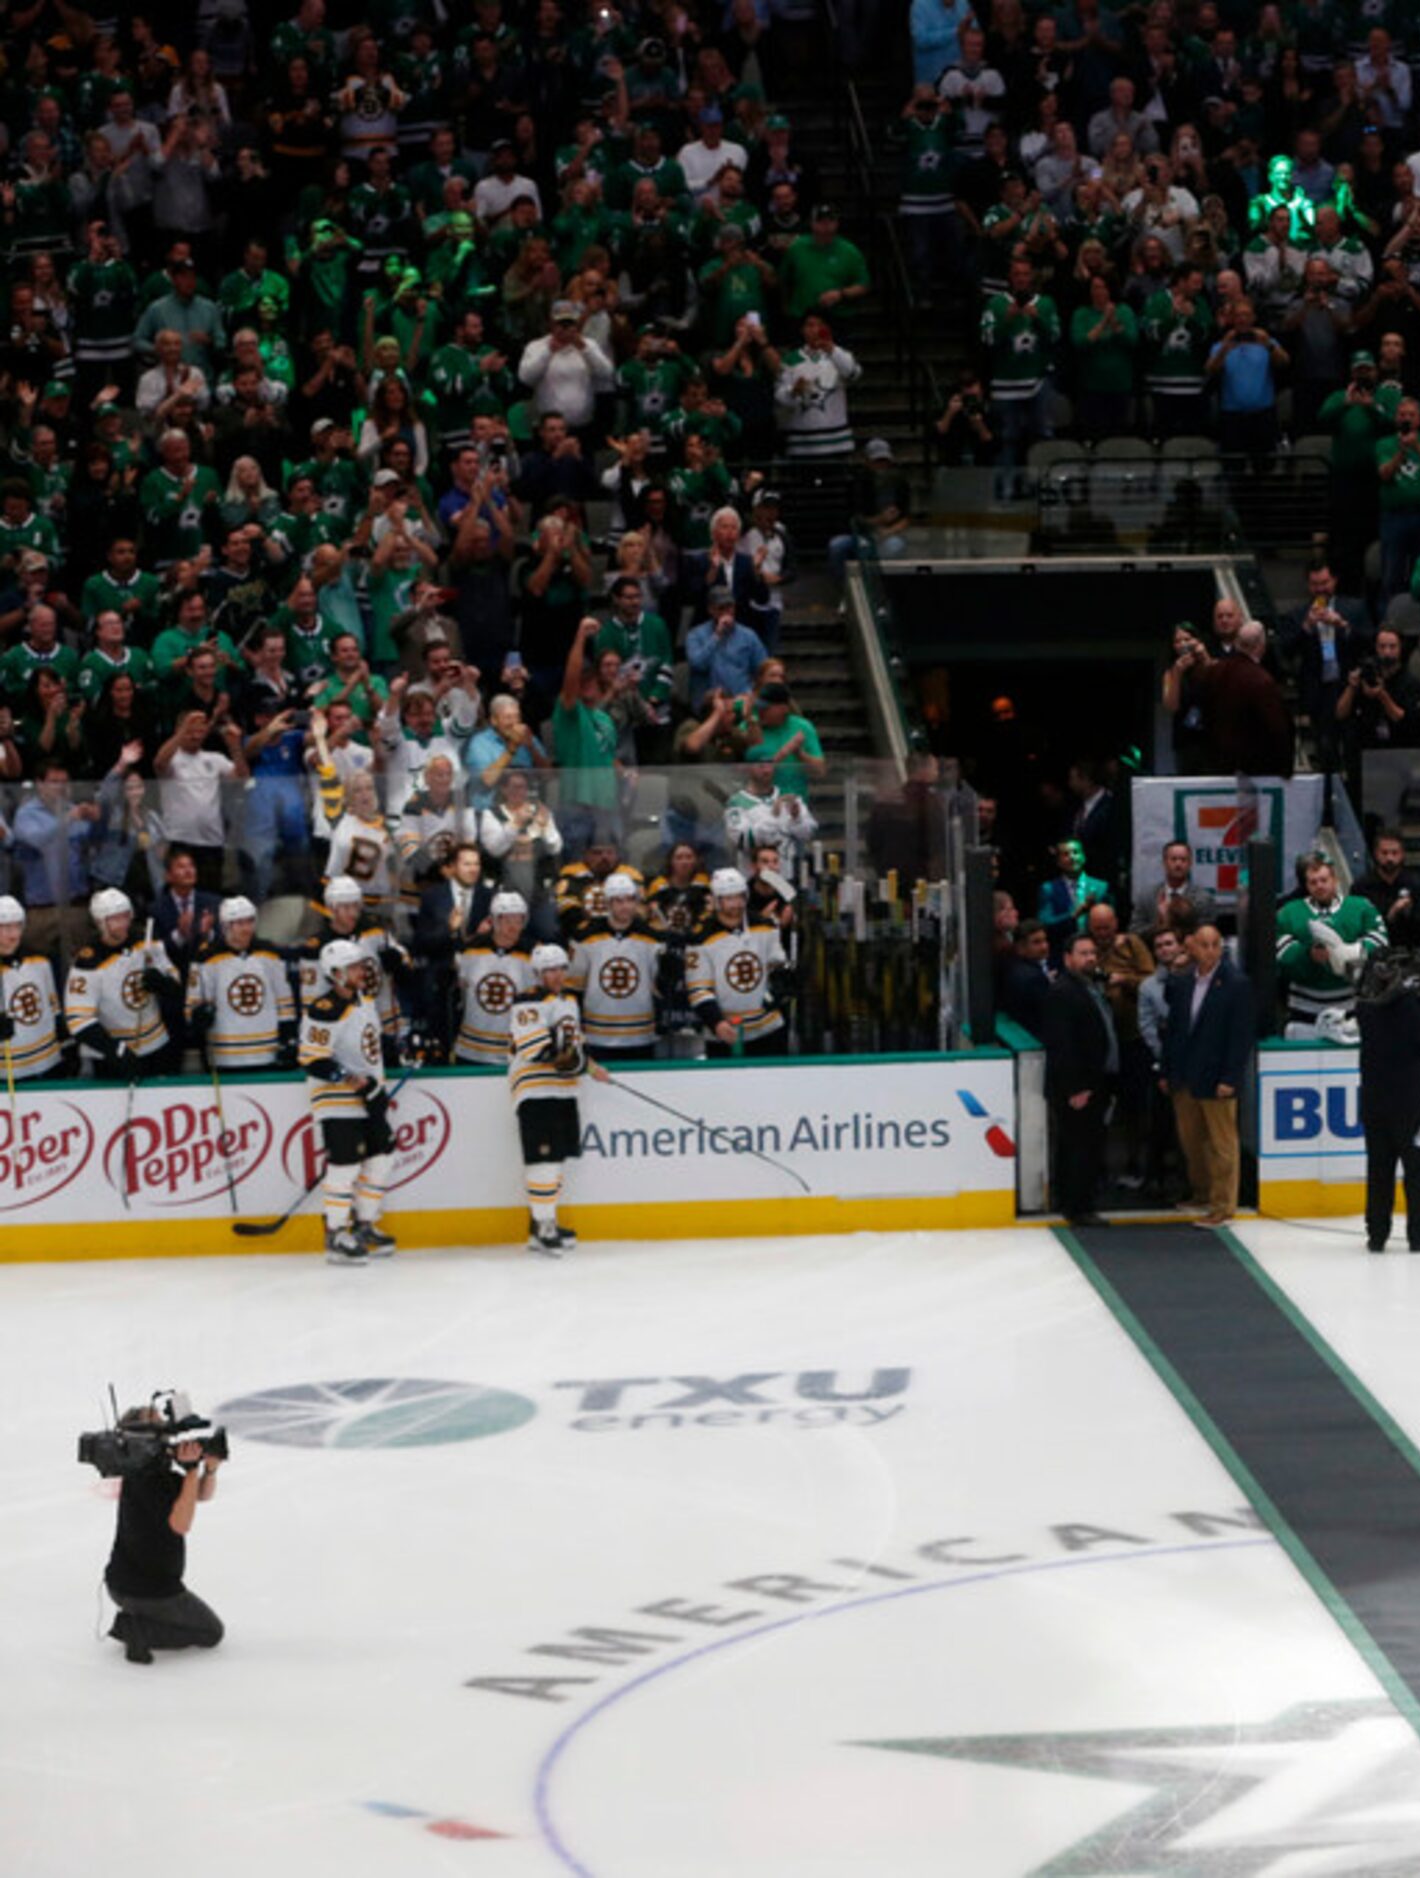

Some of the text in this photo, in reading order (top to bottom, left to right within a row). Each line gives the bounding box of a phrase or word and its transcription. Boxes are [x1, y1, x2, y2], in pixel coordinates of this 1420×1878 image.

[163, 1103, 222, 1150] Dr
[580, 1113, 951, 1159] American Airlines
[1274, 1086, 1365, 1141] BU
[124, 1115, 260, 1195] Pepper
[552, 1367, 912, 1412] TXU
[567, 1401, 907, 1433] energy
[462, 1506, 1271, 1704] AMERICAN
